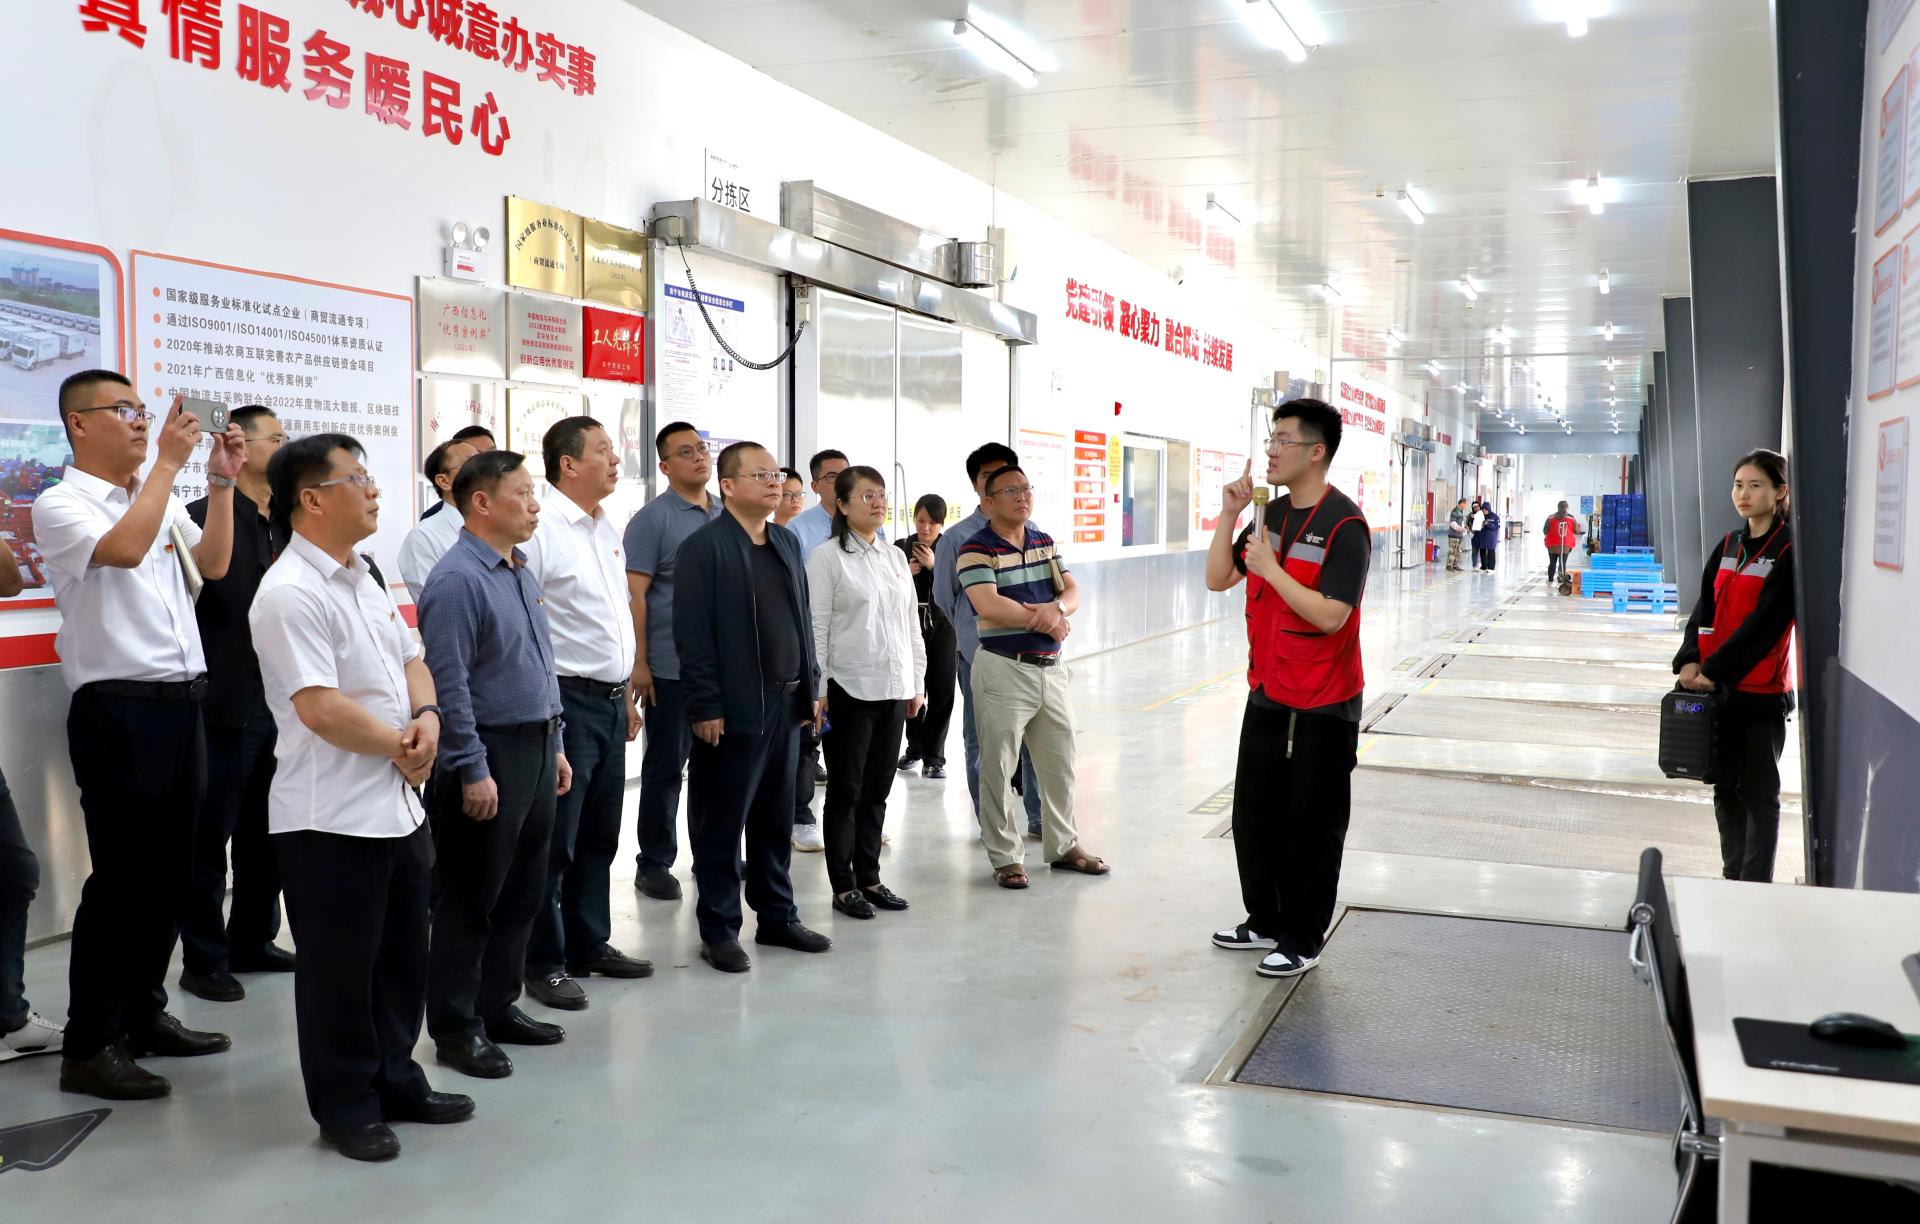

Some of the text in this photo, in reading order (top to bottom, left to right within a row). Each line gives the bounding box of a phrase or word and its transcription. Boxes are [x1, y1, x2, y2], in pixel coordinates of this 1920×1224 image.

[79, 0, 511, 157] 真情服务暖民心
[711, 176, 751, 212] 分拣区
[1065, 276, 1116, 333] 党建引领
[1119, 299, 1161, 347] 凝心聚力
[166, 312, 384, 353] 通过ISO9001/ISO14001/ISO45001体系资质认证
[166, 337, 376, 373] 2020年推动农商互联完善农产品供应链资金项目
